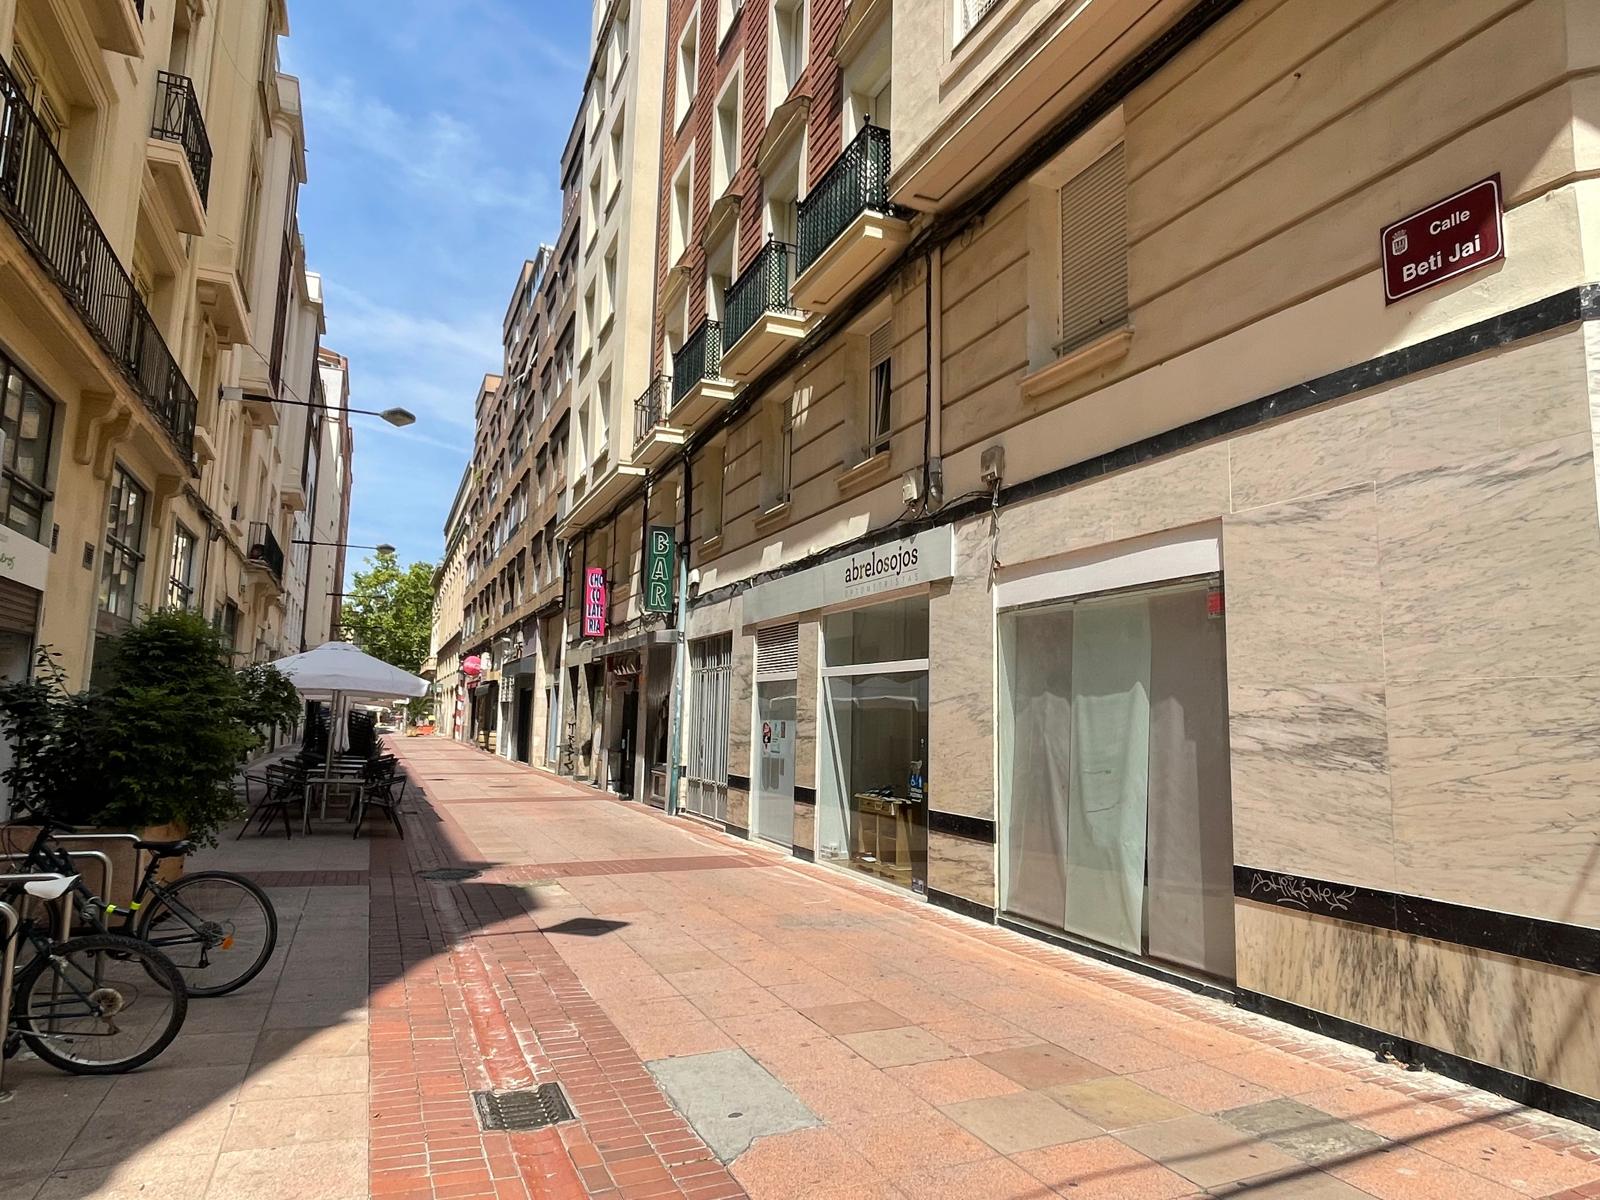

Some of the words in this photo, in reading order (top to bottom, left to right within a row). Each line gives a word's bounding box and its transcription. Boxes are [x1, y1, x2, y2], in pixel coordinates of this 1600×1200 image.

[1429, 210, 1470, 235] Calle
[1402, 251, 1442, 282] Beti
[1449, 234, 1481, 263] Jai
[650, 531, 669, 606] BAR
[845, 546, 918, 583] abrelosojos
